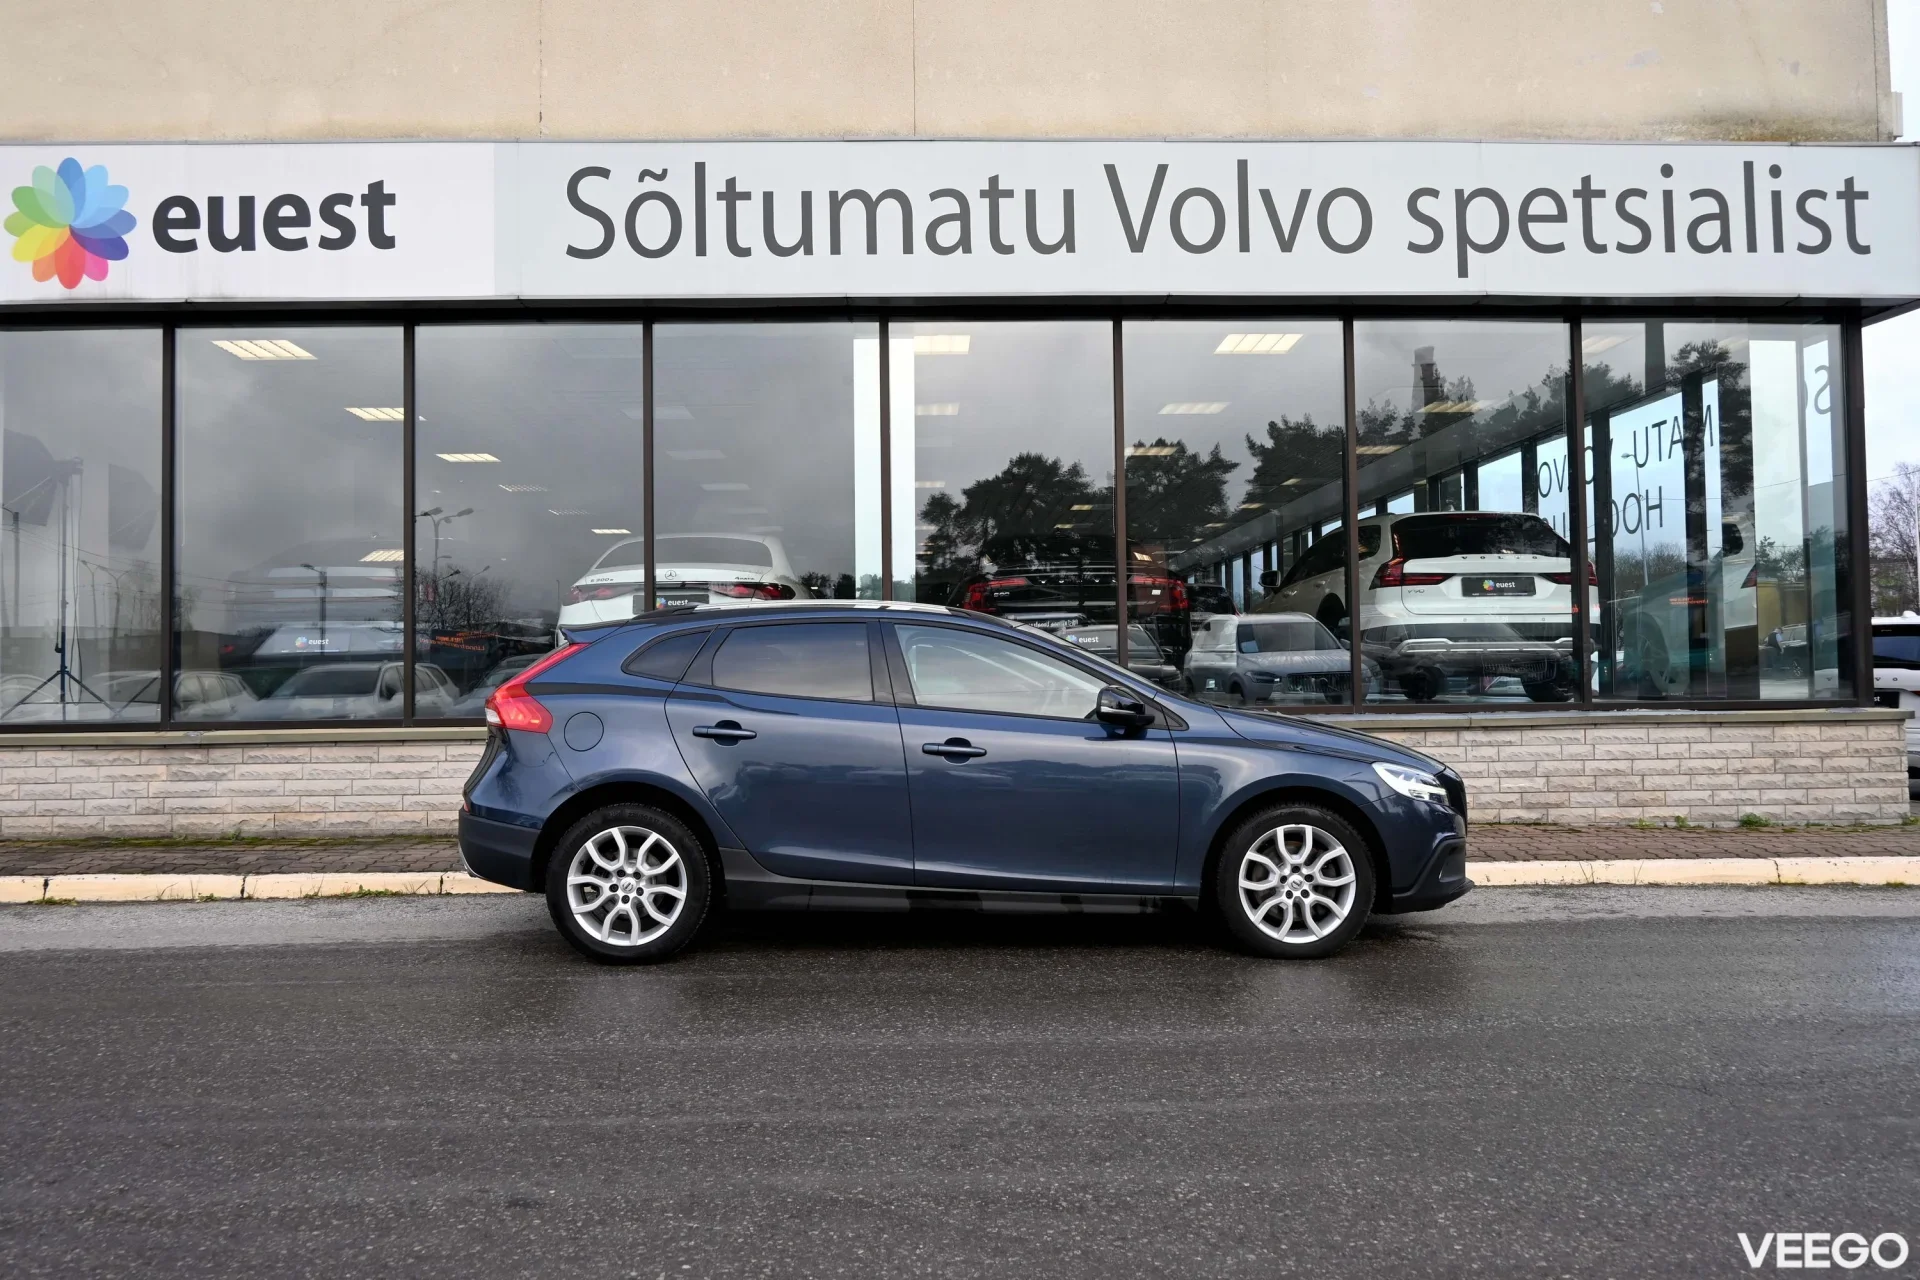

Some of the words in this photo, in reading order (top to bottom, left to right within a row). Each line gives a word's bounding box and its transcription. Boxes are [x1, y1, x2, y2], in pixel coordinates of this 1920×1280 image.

[153, 180, 396, 254] euest
[566, 162, 1076, 260] Sõltumatu
[1104, 160, 1373, 256] Volvo
[1408, 161, 1871, 279] spetsialist
